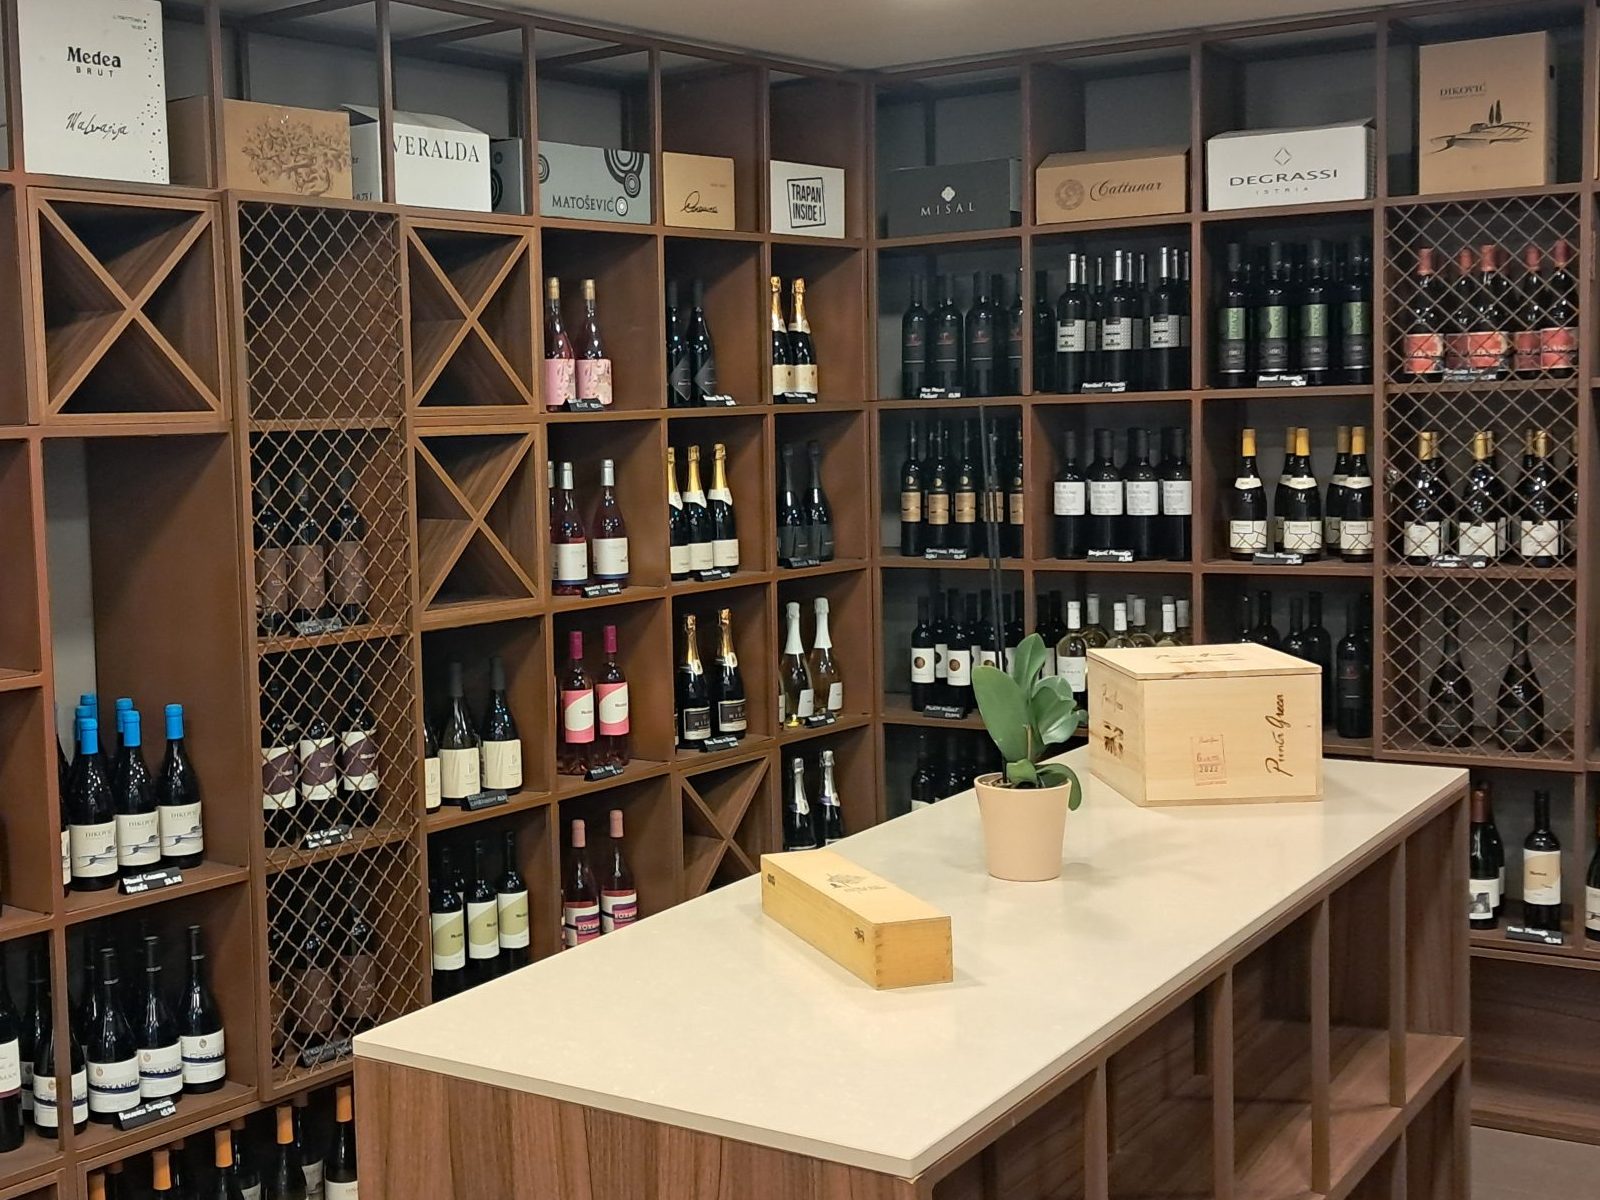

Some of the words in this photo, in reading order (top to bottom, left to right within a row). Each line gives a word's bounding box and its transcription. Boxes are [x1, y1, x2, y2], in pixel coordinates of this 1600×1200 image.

[67, 46, 122, 68] Medea
[76, 65, 114, 78] BRUT
[393, 135, 480, 162] VERALDA
[1229, 169, 1338, 187] DEGRASSI
[791, 183, 822, 203] TRAPAN
[1089, 179, 1163, 202] Cattunar
[1255, 186, 1309, 196] ISTRIA
[552, 194, 615, 213] MATOŠEVIĆ
[792, 203, 818, 222] INSIDE
[920, 202, 976, 217] MISAL
